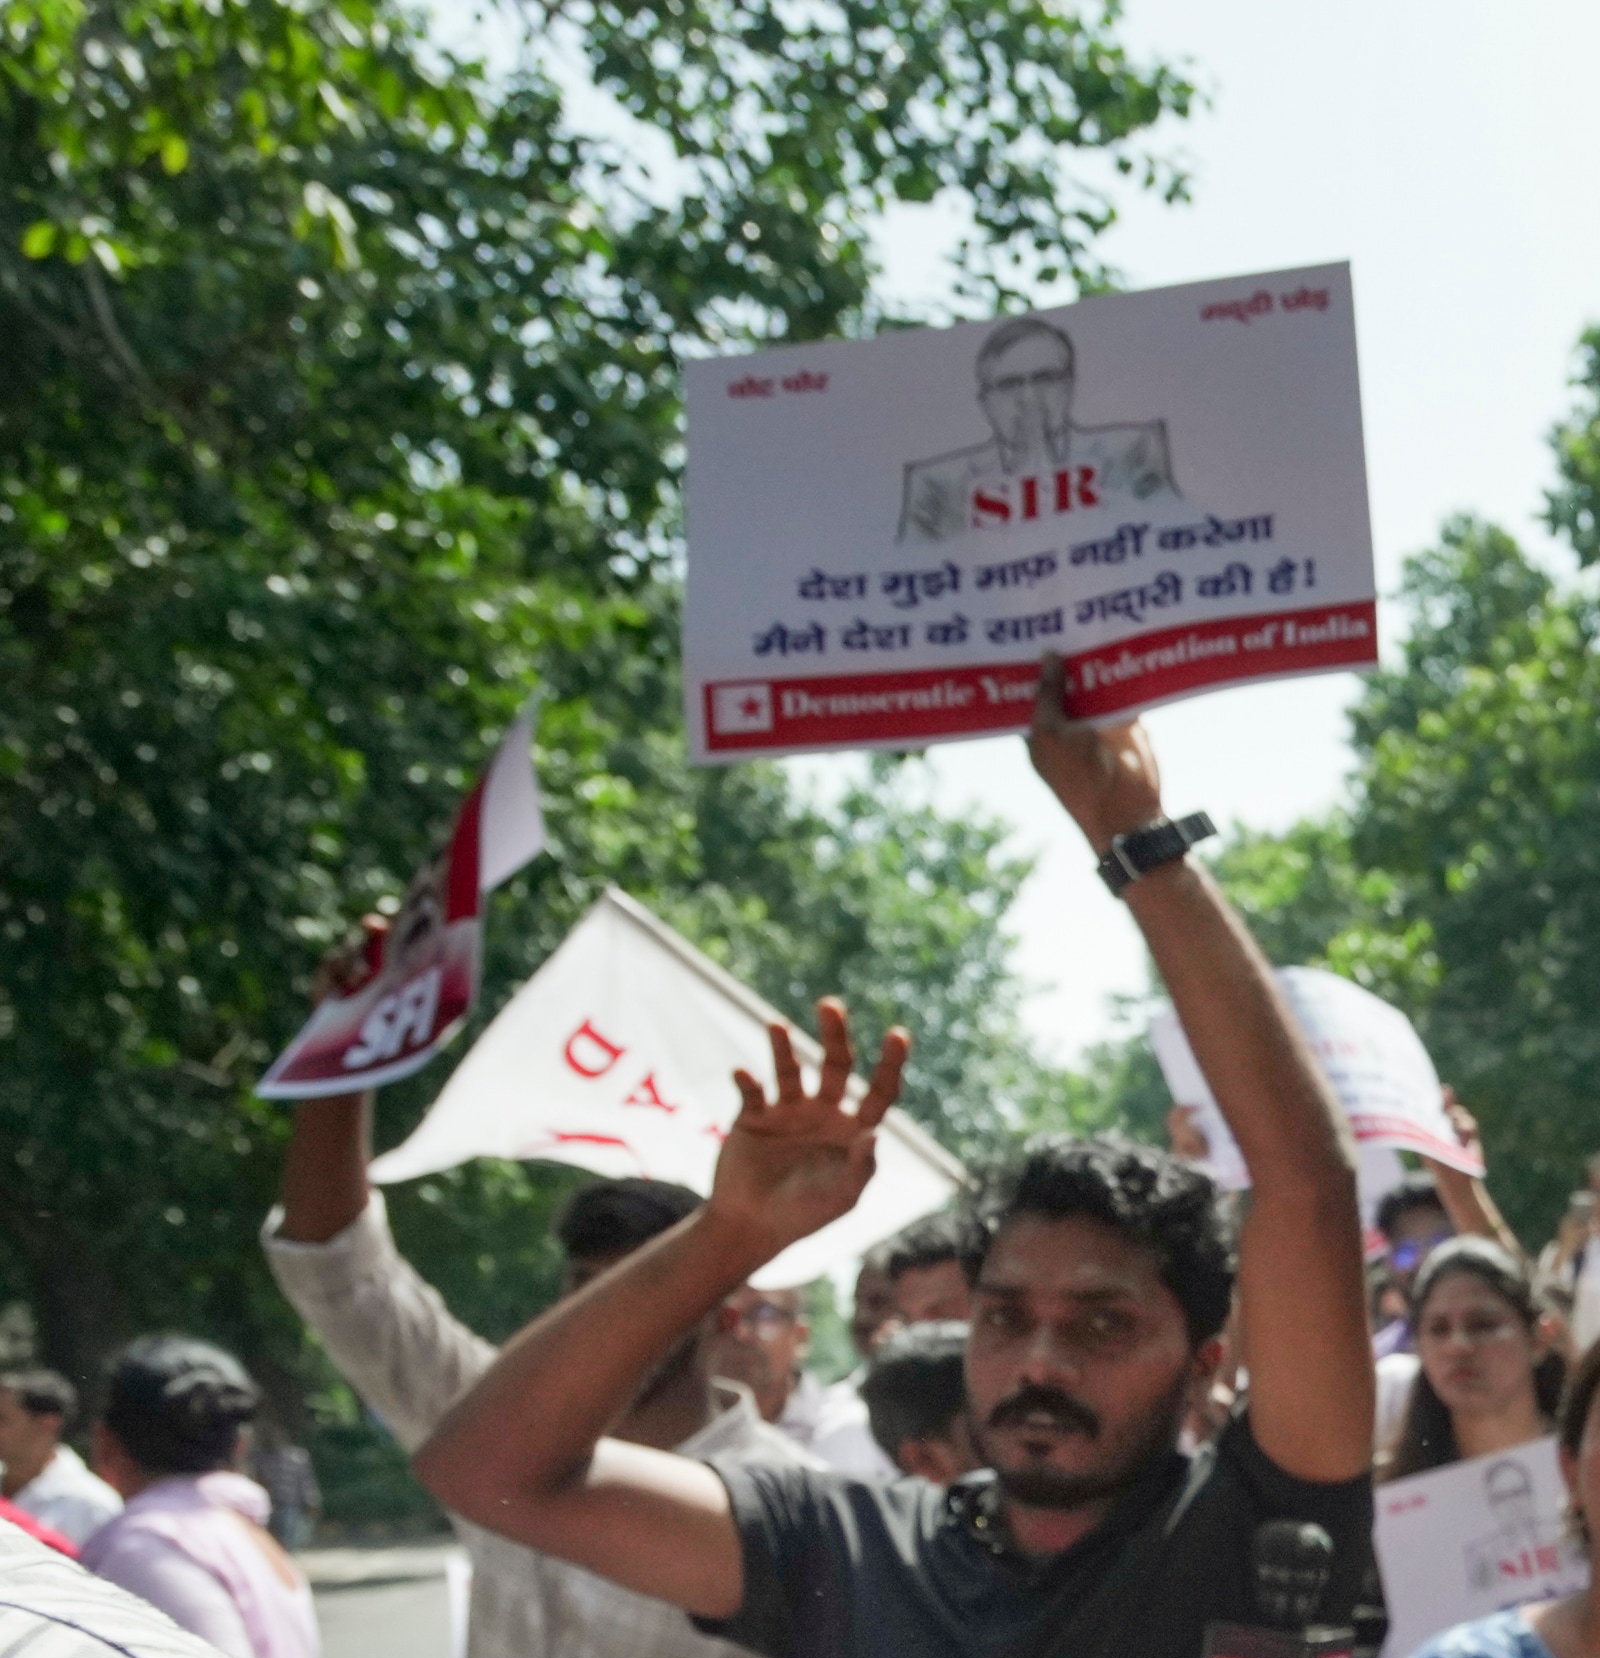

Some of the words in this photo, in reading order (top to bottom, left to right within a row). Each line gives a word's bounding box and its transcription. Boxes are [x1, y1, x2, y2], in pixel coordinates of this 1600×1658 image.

[972, 464, 1099, 528] SIR
[797, 567, 866, 600] देश
[880, 560, 960, 609] मुझे
[1069, 523, 1149, 566] नहीं
[1157, 513, 1274, 548] करेगा
[841, 616, 910, 650] देश
[925, 612, 969, 645] के
[984, 607, 1064, 645] साथ
[1196, 561, 1253, 597] की
[781, 681, 974, 719] Democratic
[980, 674, 1075, 704] You
[1080, 633, 1238, 691] Federation
[1243, 622, 1279, 650] of
[1282, 615, 1370, 647] India
